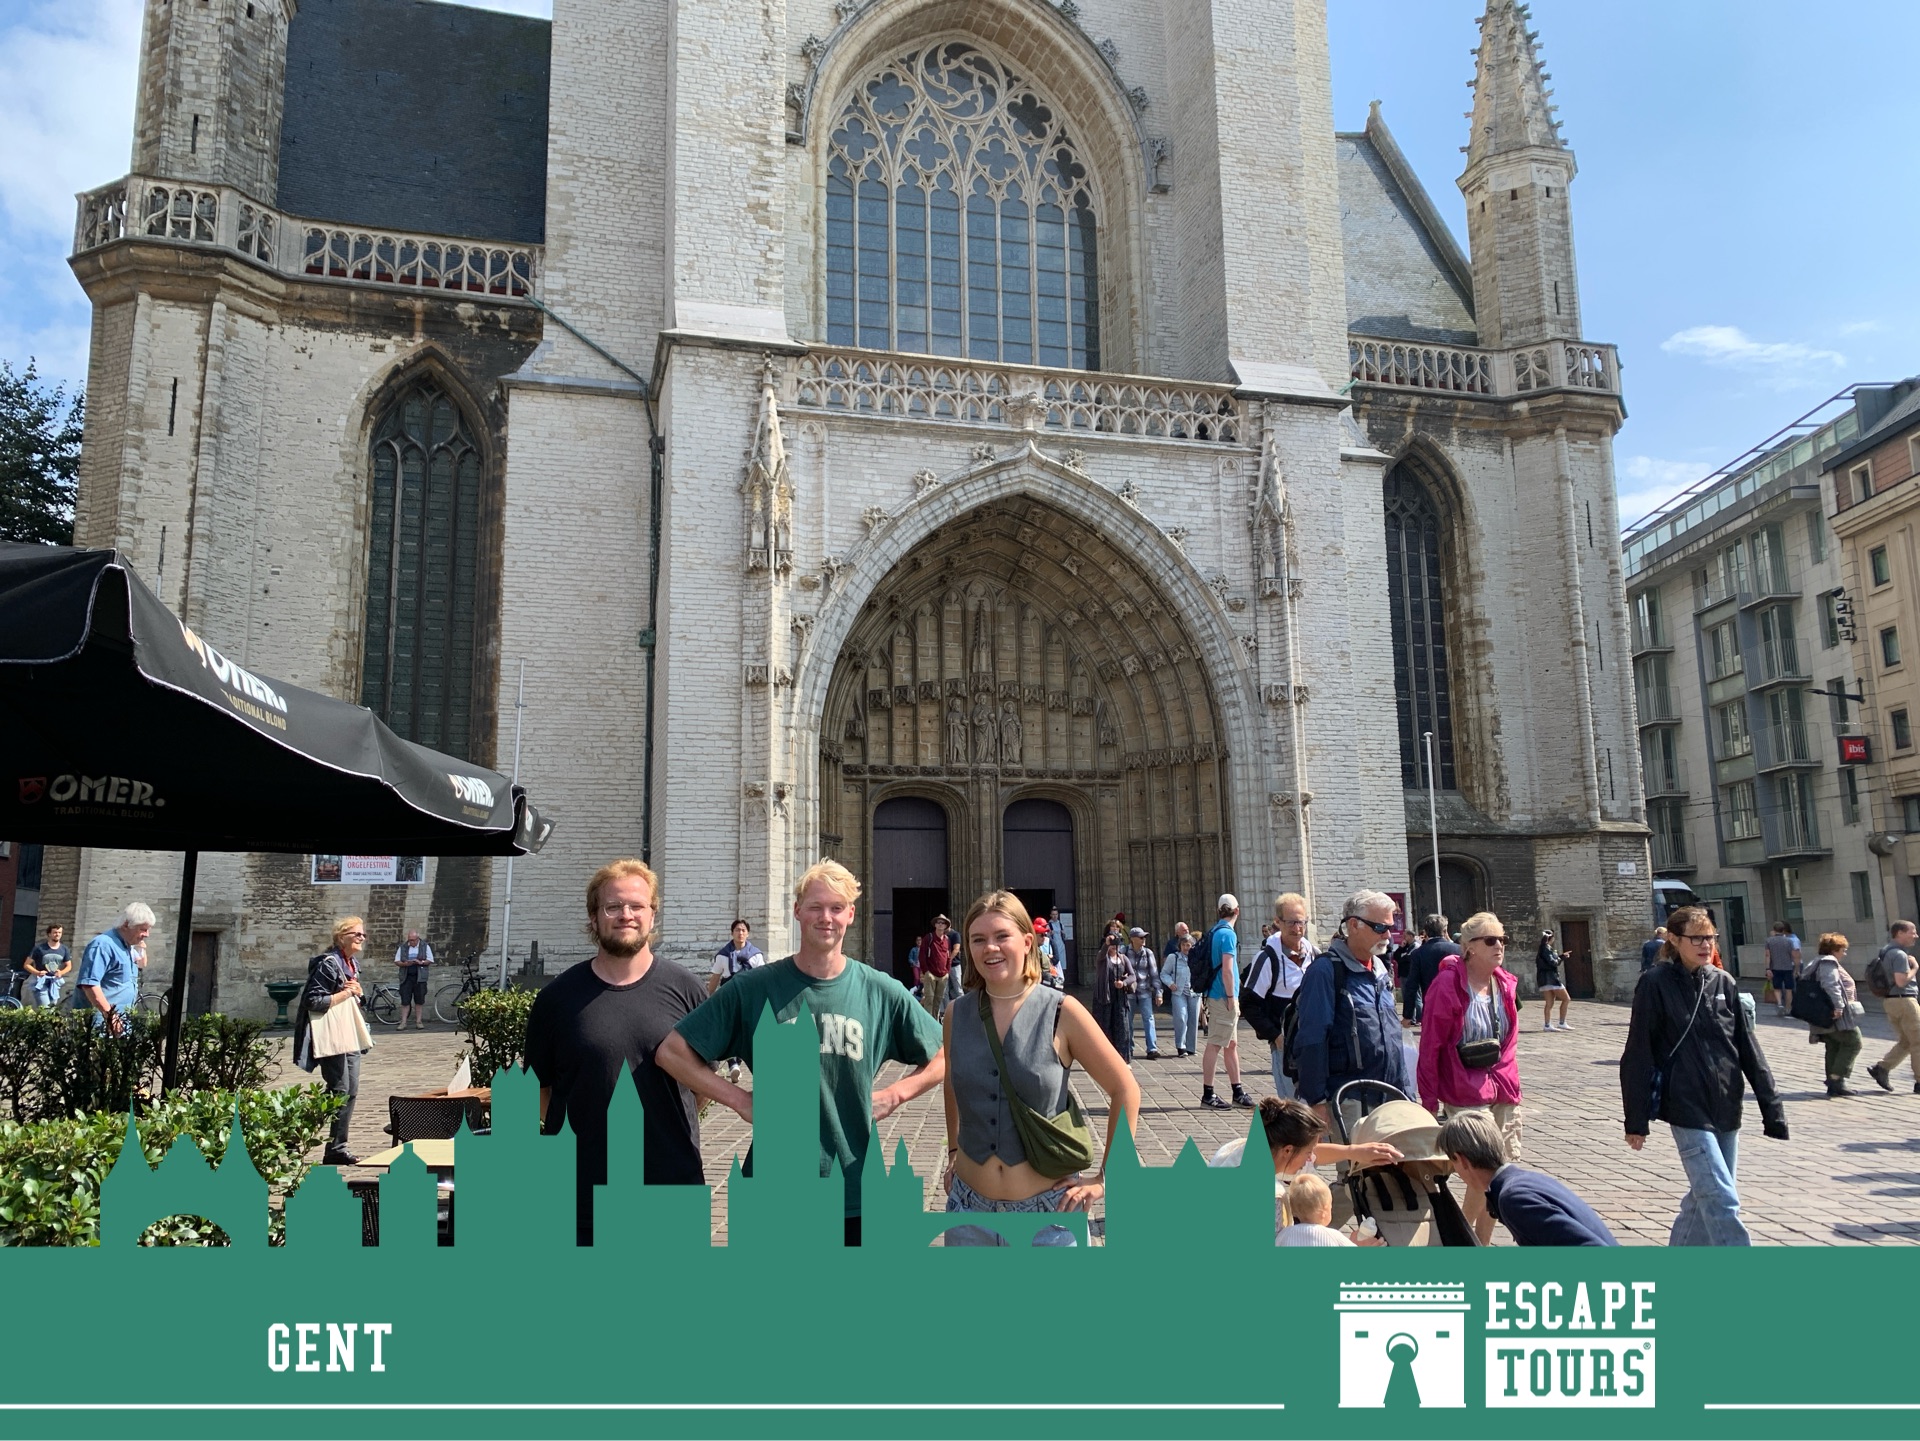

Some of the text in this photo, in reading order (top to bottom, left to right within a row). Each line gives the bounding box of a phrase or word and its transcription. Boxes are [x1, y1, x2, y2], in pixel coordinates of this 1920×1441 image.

[1848, 744, 1866, 753] ibis
[49, 774, 166, 807] OMER.
[54, 806, 155, 819] TRADITIONAL BLOND
[347, 861, 391, 869] ORGELFESTIVAL
